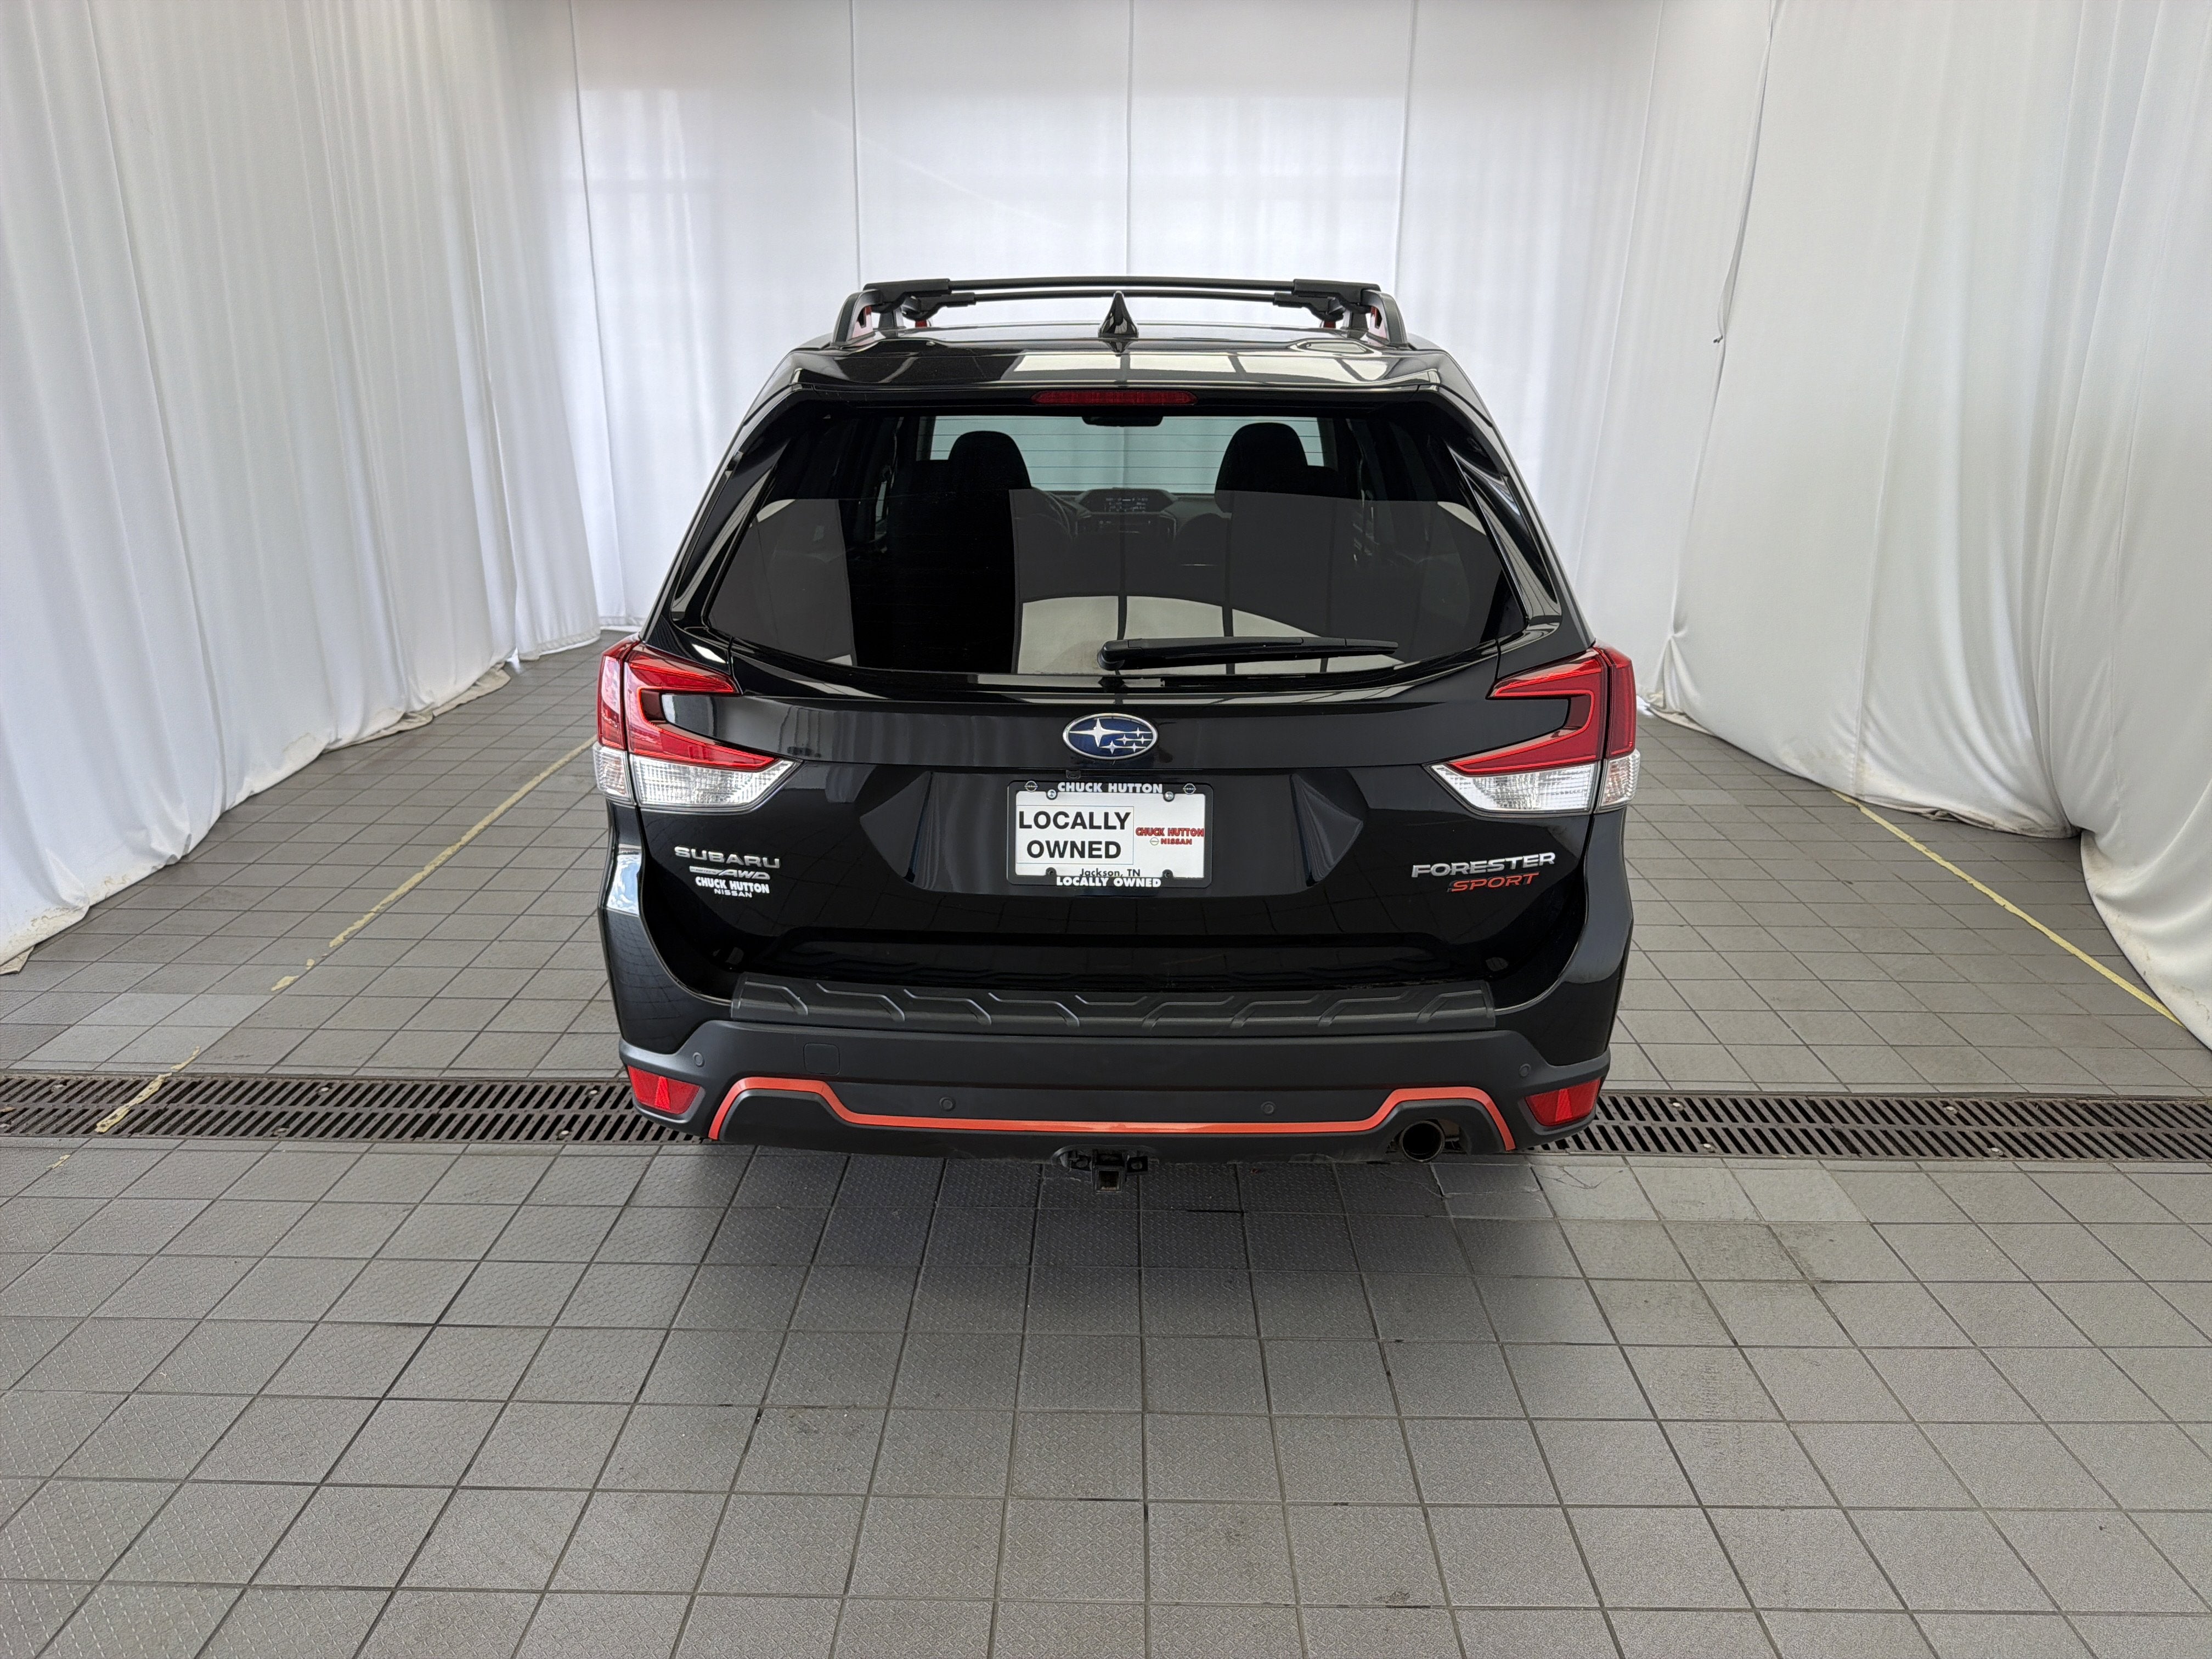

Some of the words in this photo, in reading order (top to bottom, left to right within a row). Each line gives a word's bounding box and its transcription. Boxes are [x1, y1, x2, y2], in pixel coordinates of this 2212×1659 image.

[1058, 782, 1102, 793] CHUCK
[1108, 783, 1163, 793] HUTTON
[1019, 811, 1131, 830] LOCALLY
[1136, 827, 1165, 836] CHUCK
[1167, 828, 1204, 837] HUTTON
[1026, 840, 1121, 859] OWNED
[674, 846, 780, 869] SUBARU
[1411, 852, 1556, 878] FORESTER
[718, 869, 770, 880] AWD
[1127, 868, 1141, 877] TN
[695, 876, 727, 889] CHUCK
[730, 880, 770, 894] HUTTON
[1056, 877, 1109, 887] LOCALLY
[1114, 877, 1161, 888] OWNED
[1451, 872, 1539, 892] SPORT
[714, 888, 752, 898] NISSAN
